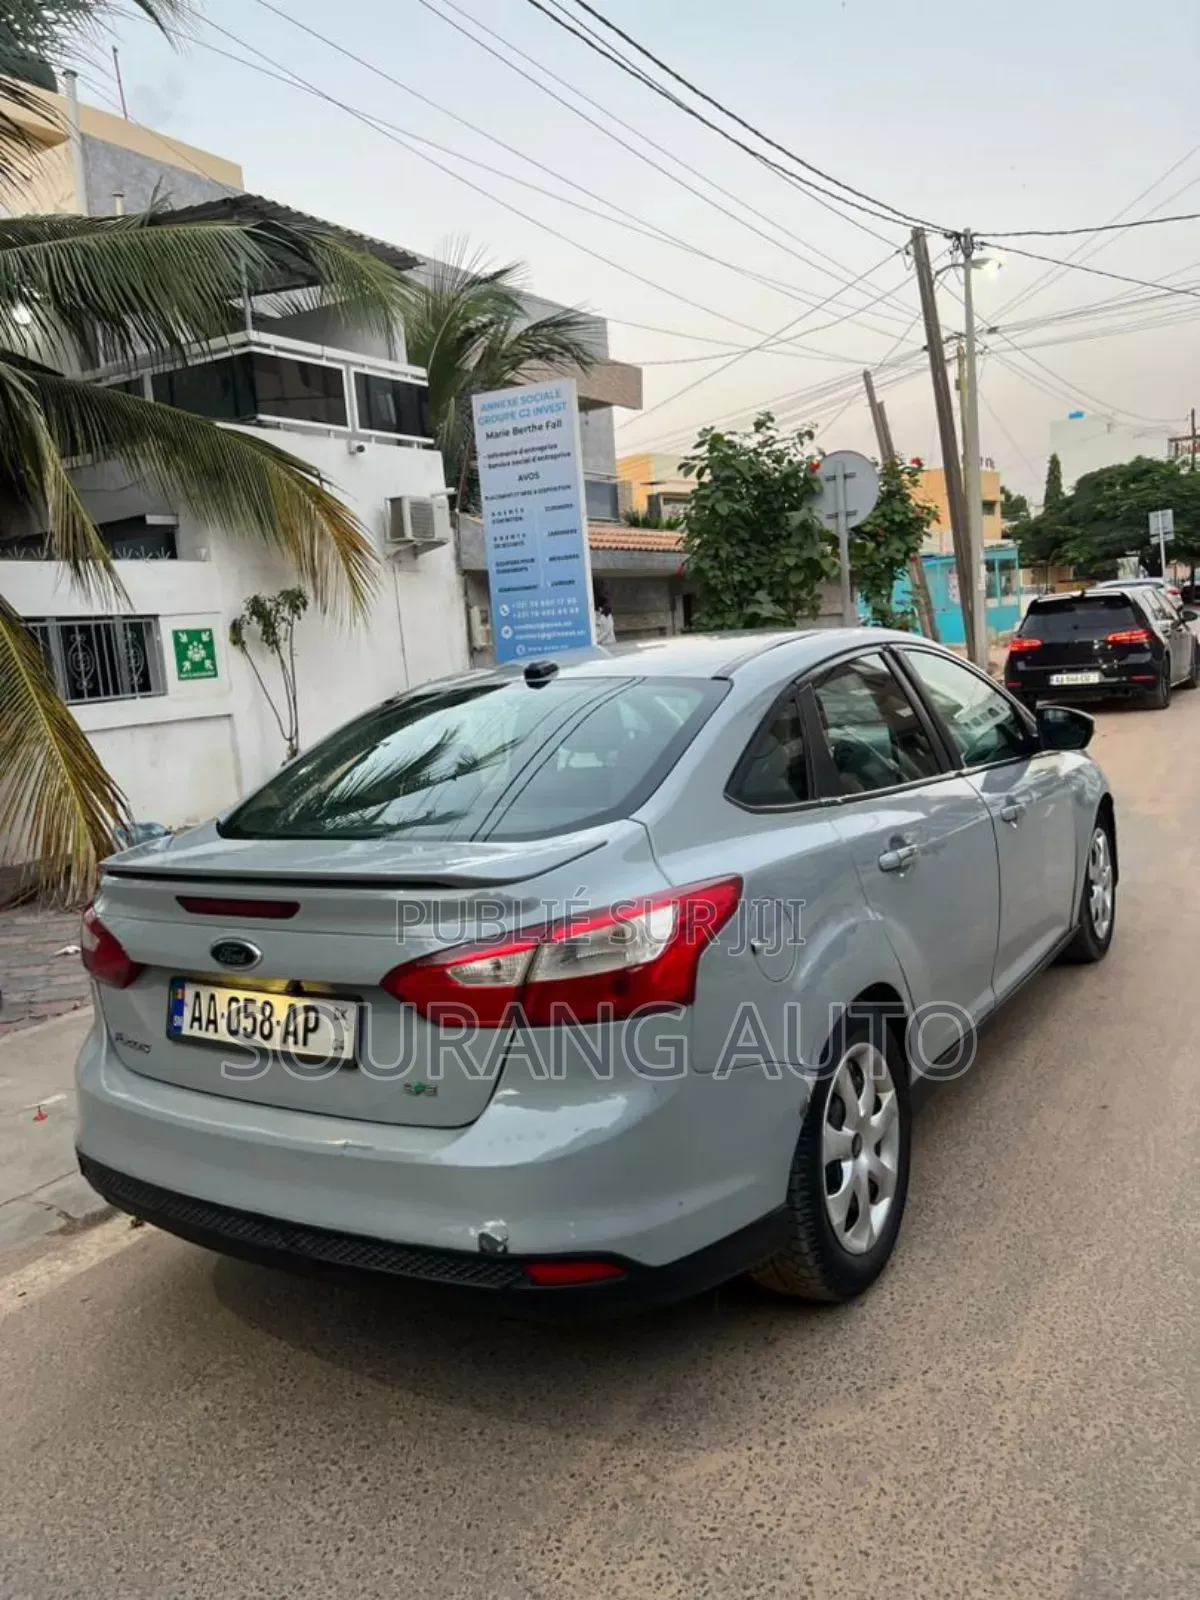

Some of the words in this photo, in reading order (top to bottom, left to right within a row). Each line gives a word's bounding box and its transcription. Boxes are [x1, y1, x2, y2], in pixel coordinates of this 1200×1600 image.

[520, 388, 561, 407] SOCIALE
[478, 411, 517, 426] GROUPE
[533, 401, 567, 415] INVEST
[485, 429, 510, 440] Marie
[512, 423, 544, 436] Berthe
[546, 419, 562, 431] Fall
[517, 471, 540, 482] AVOS
